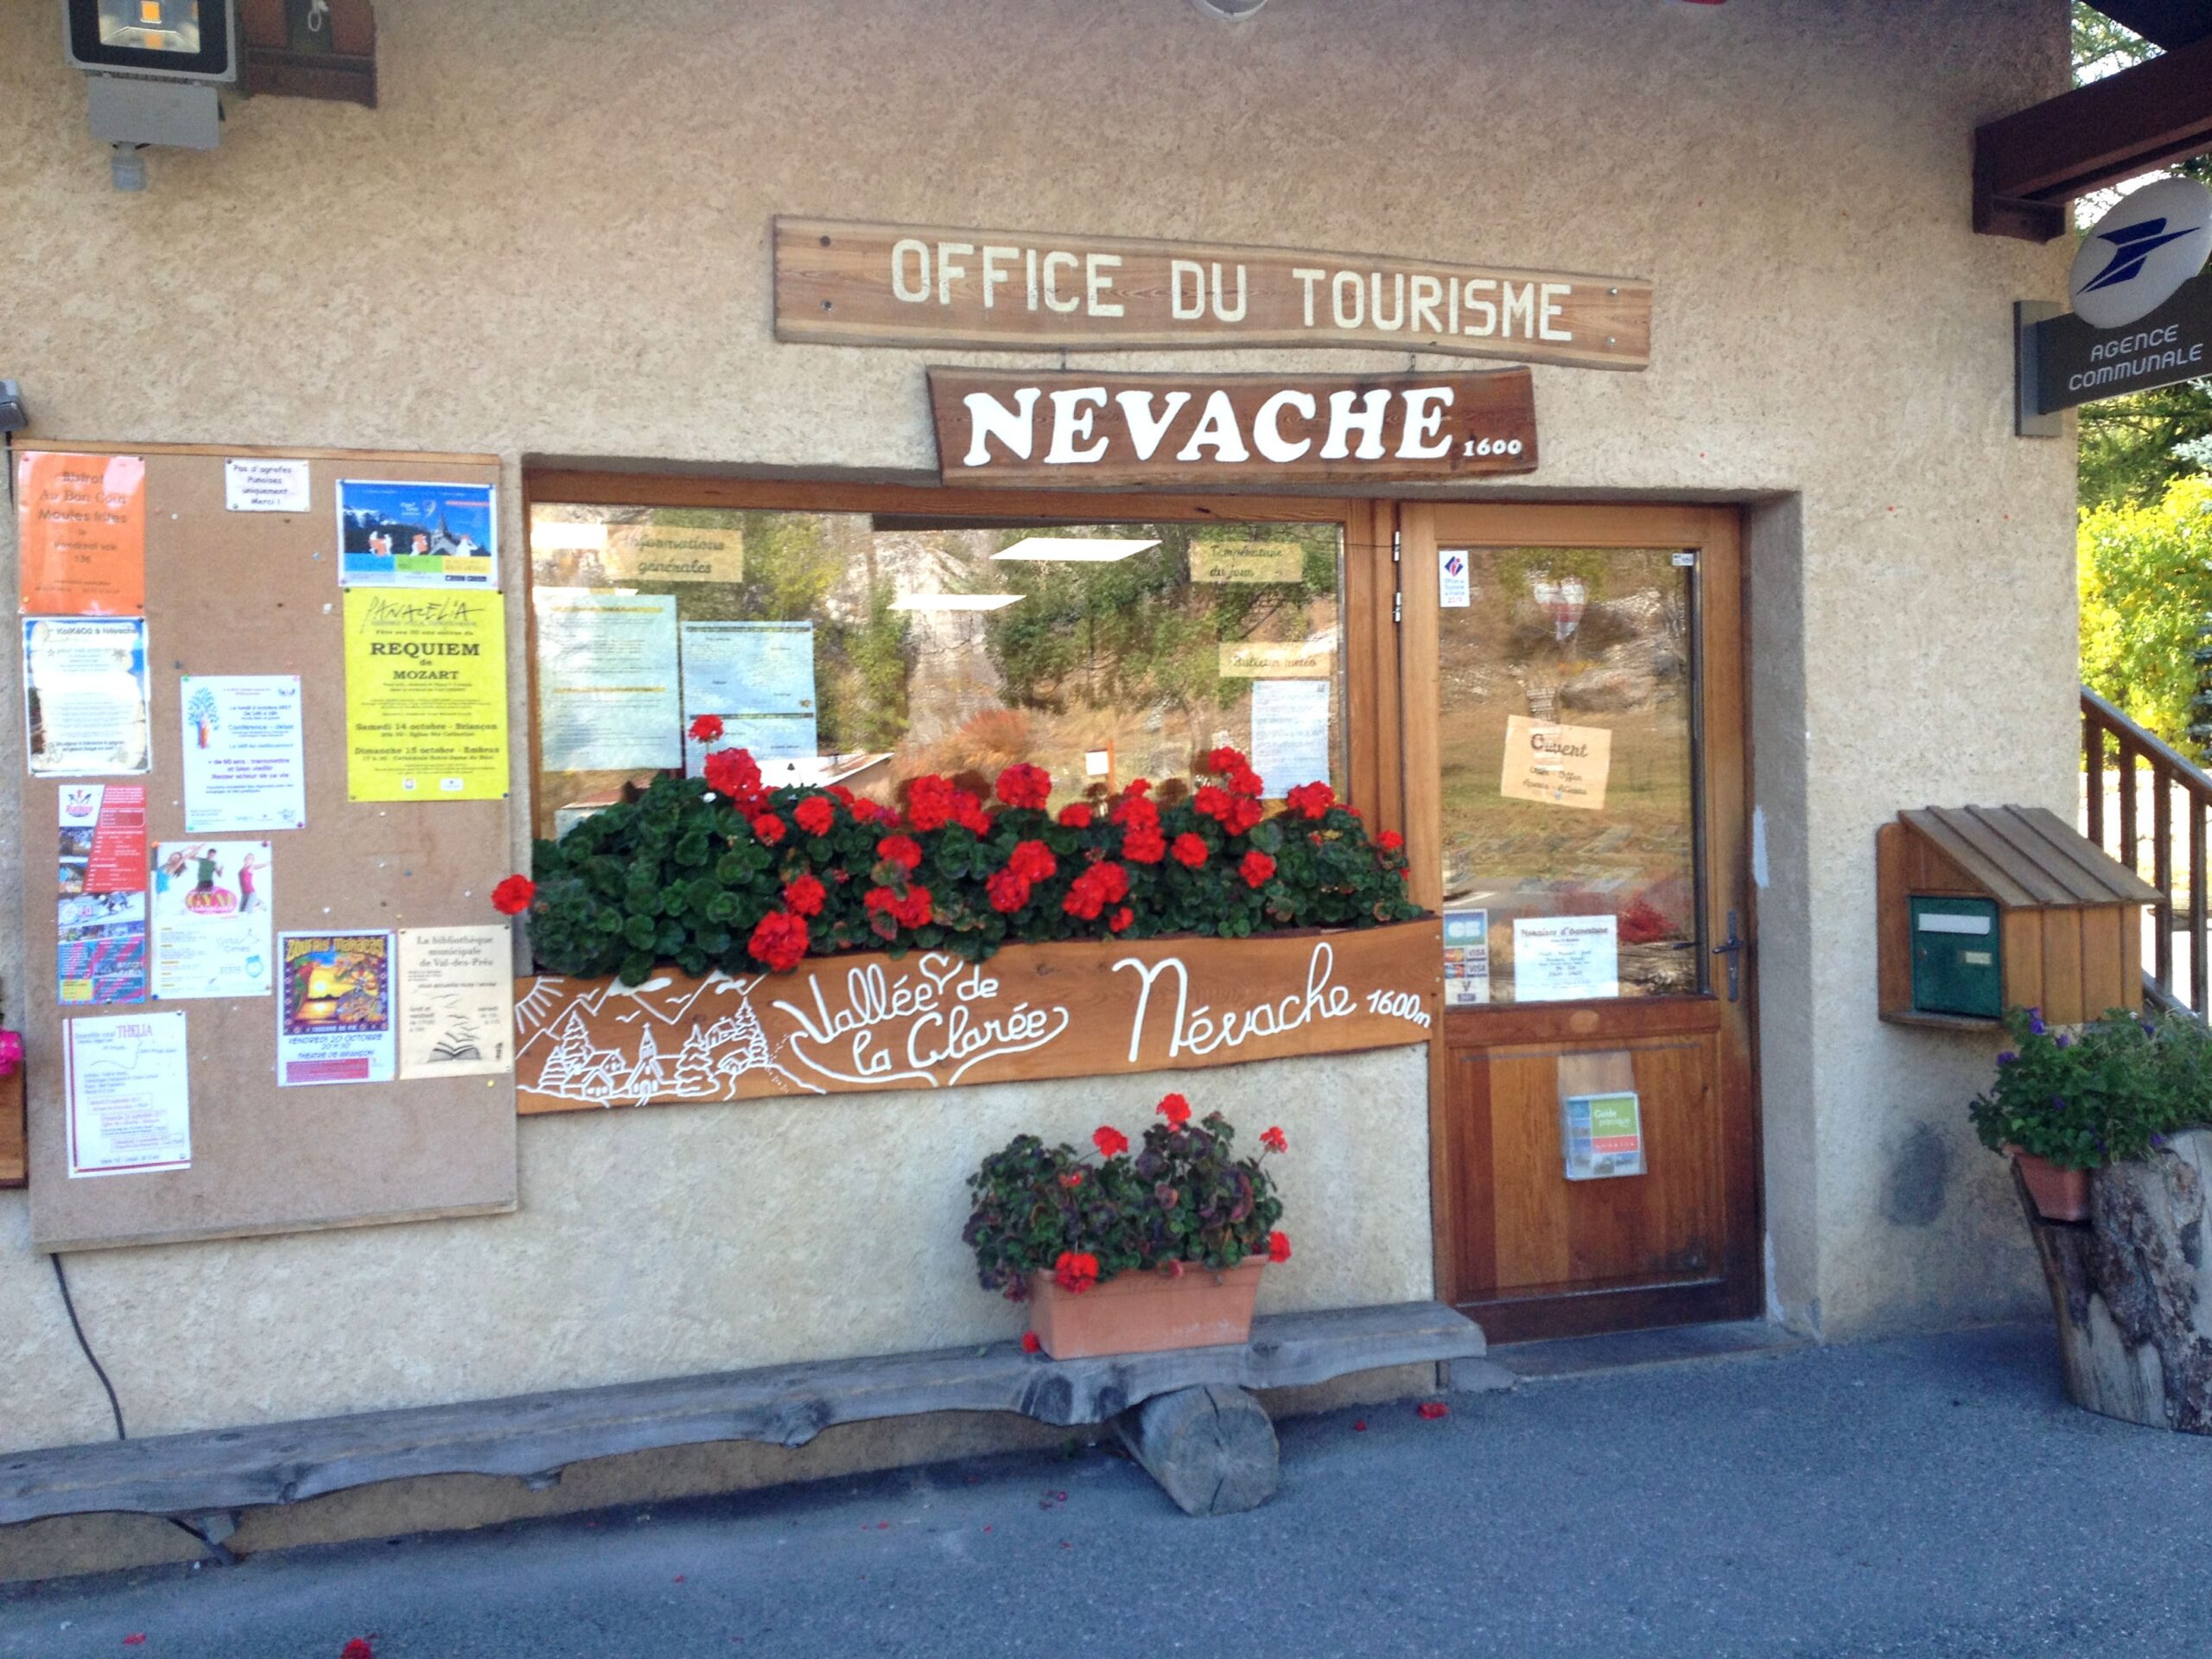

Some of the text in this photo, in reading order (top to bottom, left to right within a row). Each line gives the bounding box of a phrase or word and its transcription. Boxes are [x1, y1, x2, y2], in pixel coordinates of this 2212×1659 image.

[891, 238, 1573, 341] OFFICE DU TOURISME
[2068, 342, 2204, 391] COMMUNALE
[2089, 323, 2179, 362] AGENCE
[963, 386, 1523, 465] NEVACHE 1600
[247, 475, 283, 484] Punaises
[1209, 564, 1225, 577] du
[370, 642, 480, 658] REQUIEM
[392, 670, 460, 680] MOZART
[773, 963, 999, 1044] Vallée de
[1111, 942, 1432, 1063] Névache 1600m
[852, 1002, 1048, 1076] la Clarée
